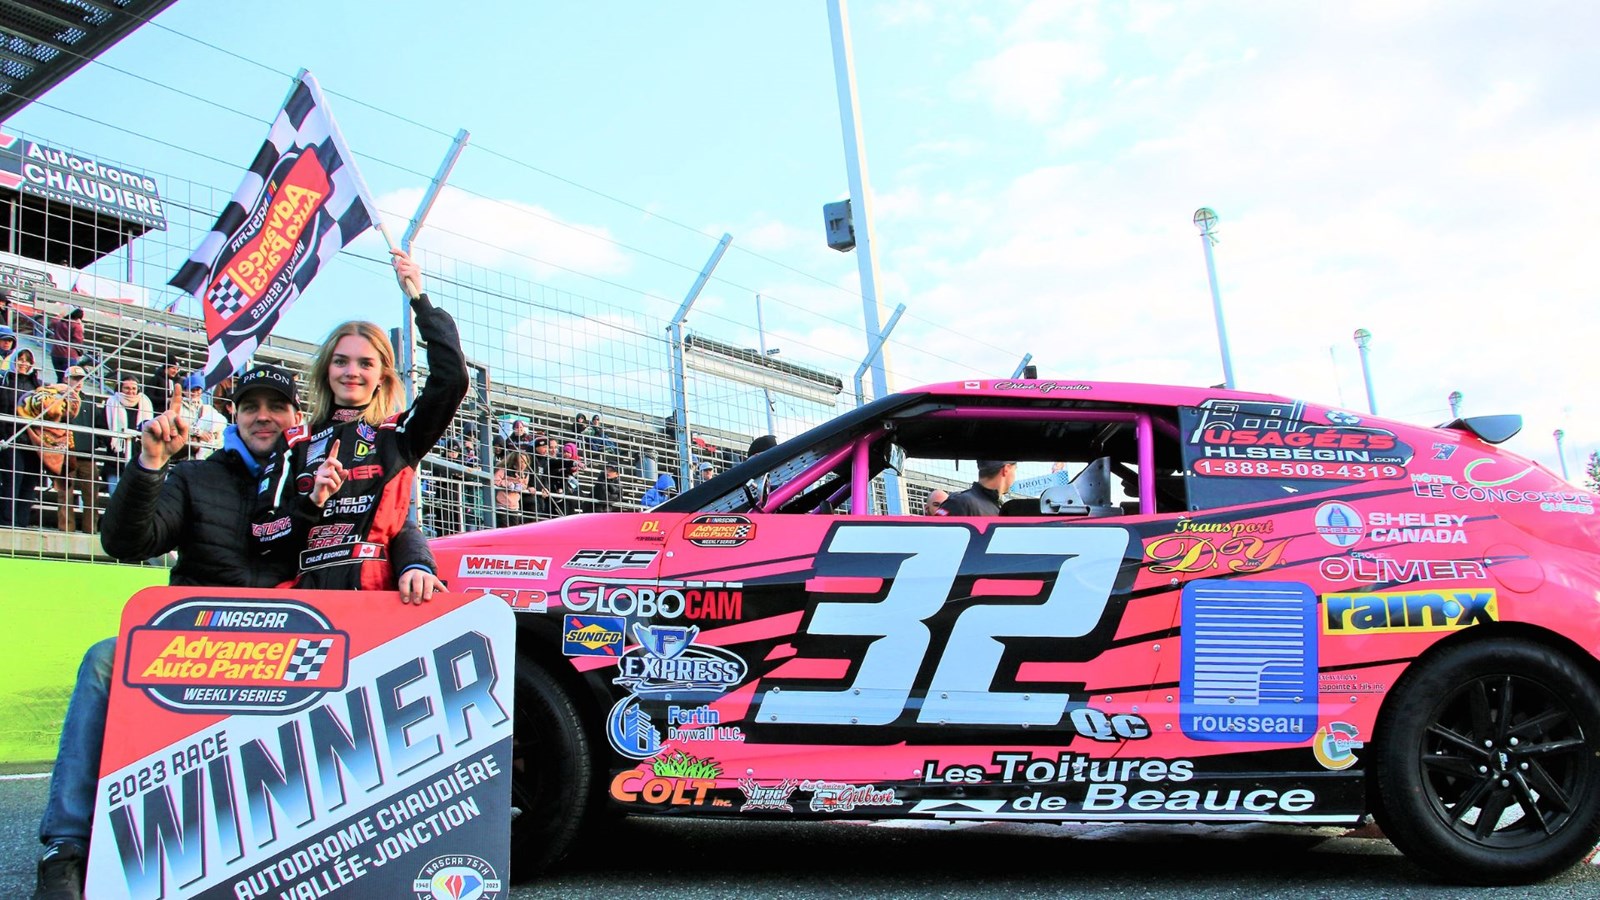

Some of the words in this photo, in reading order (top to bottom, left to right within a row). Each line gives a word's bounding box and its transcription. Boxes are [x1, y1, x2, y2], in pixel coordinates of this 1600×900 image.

[27, 141, 156, 193] Autodrome
[24, 163, 162, 217] CHAUDIERE
[1203, 428, 1396, 450] USAGÉES
[1200, 460, 1398, 478] 1-888-508-4319
[326, 494, 376, 508] SHELBY
[1413, 483, 1445, 498] LE
[1451, 485, 1592, 504] CONCORDE
[323, 503, 372, 517] CANADA
[1368, 512, 1469, 527] SHELBY
[640, 520, 659, 532] DL
[709, 530, 733, 538] Parts
[1174, 519, 1274, 537] Transport
[1370, 528, 1468, 544] CANADA
[466, 556, 548, 571] WHELEN
[570, 550, 658, 564] PFC
[1319, 557, 1487, 583] OLIVIER
[217, 611, 289, 628] NASCAR
[755, 525, 1130, 726] 32
[566, 630, 622, 644] SUNOCO
[159, 635, 284, 660] Advance
[141, 658, 208, 679] Auto
[207, 658, 276, 680] Parts
[625, 656, 740, 683] EXPRESS
[183, 688, 240, 702] WEEKLY
[238, 689, 288, 703] SERIES
[668, 705, 720, 725] Fortin
[1192, 714, 1304, 733] rousseau
[668, 726, 715, 743] Drywall
[717, 726, 746, 741] LLC.
[108, 630, 510, 900] WINNER
[108, 759, 167, 807] 2023
[171, 729, 229, 776] RACE
[924, 763, 984, 784] Les
[996, 754, 1195, 784] Toitures
[610, 769, 717, 806] COLT
[837, 786, 894, 806] Gilbert
[1011, 791, 1067, 811] de
[1081, 783, 1316, 812] Beauce
[233, 817, 378, 900] AUTODROME
[376, 754, 501, 832] CHAUDIÉRE
[425, 857, 464, 876] NASCAR
[466, 857, 491, 876] 75TH
